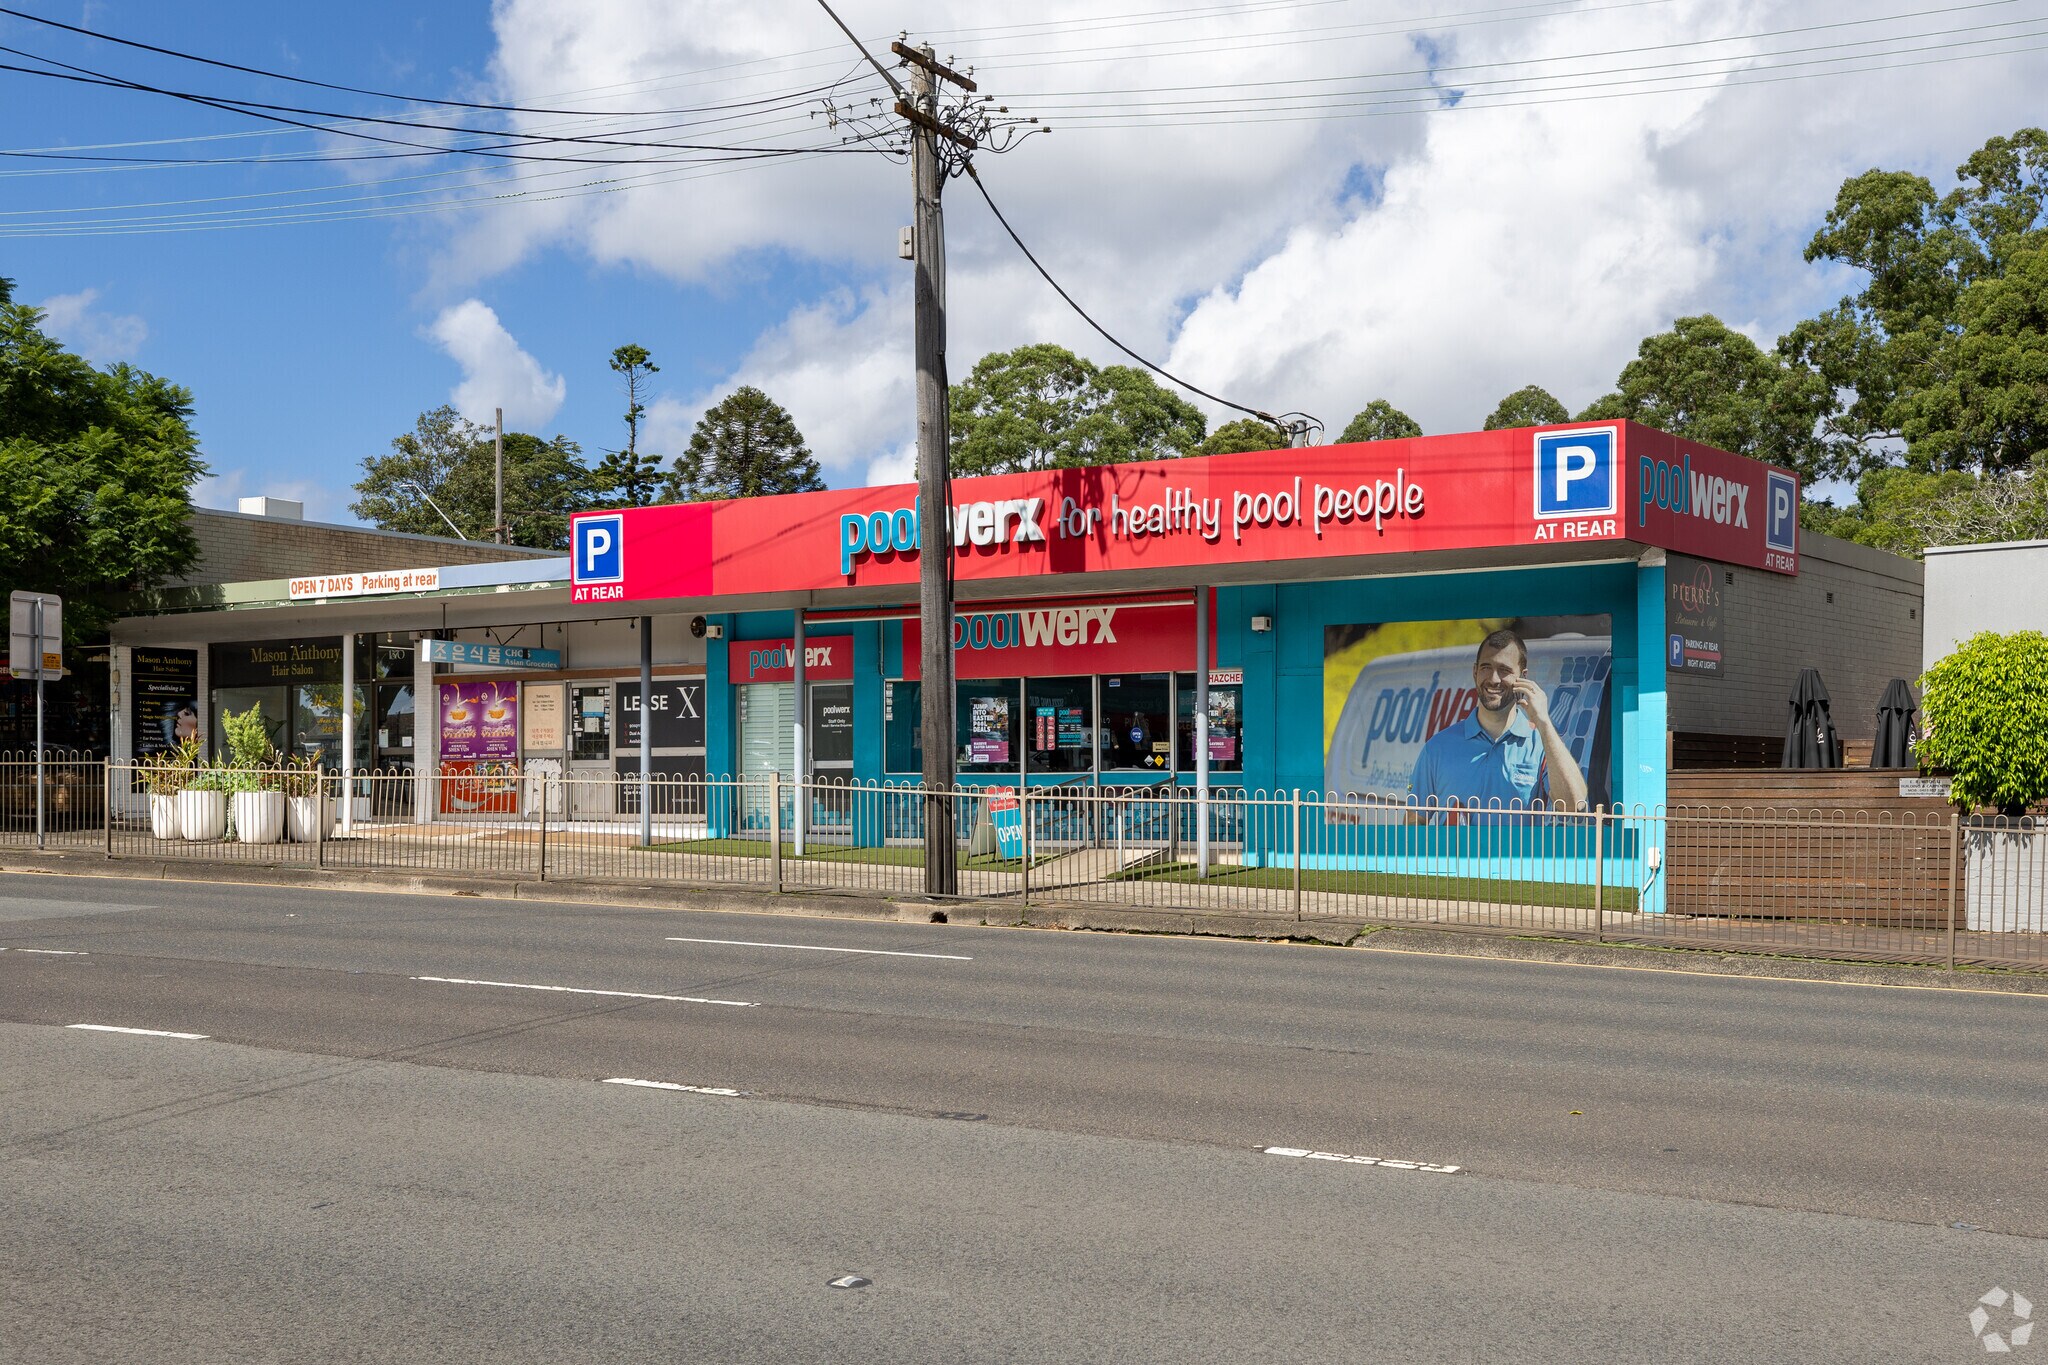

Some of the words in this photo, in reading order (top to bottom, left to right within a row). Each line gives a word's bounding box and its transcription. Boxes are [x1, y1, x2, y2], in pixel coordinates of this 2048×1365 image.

[1556, 445, 1597, 502] P
[1639, 453, 1750, 529] poolwerx
[1057, 496, 1101, 539] for
[1112, 487, 1222, 540] healthy
[1234, 476, 1302, 541] pool
[1314, 468, 1425, 535] people
[1774, 487, 1790, 536] P
[1534, 522, 1558, 541] AT
[1563, 519, 1617, 538] REAR
[587, 528, 611, 572] P
[1765, 552, 1776, 567] AT
[1776, 556, 1794, 572] REAR
[291, 580, 317, 595] OPEN
[319, 579, 325, 592] 7
[328, 576, 354, 592] DAYS
[362, 575, 401, 591] Parking
[403, 573, 413, 587] at
[415, 574, 438, 586] rear
[574, 587, 589, 601] AT
[592, 585, 624, 600] REAR
[1672, 583, 1720, 607] PIERRE'S
[250, 647, 288, 663] Mason
[290, 643, 341, 664] Anthony
[433, 642, 501, 664] 조은식품
[1673, 640, 1680, 660] P
[1685, 639, 1703, 650] PARKING
[1708, 642, 1719, 652] REAR
[137, 654, 161, 664] Mason
[162, 656, 193, 668] Anthony
[272, 665, 290, 677] Hair
[291, 663, 315, 676] Salon
[504, 659, 524, 667] Asian
[525, 660, 558, 669] Groceries
[1687, 659, 1699, 668] RIGHT
[1704, 661, 1717, 670] LIGHTS
[148, 684, 179, 693] Specialising
[623, 694, 669, 711] LESE
[823, 704, 851, 717] poolwerx
[998, 824, 1023, 843] OPEN
